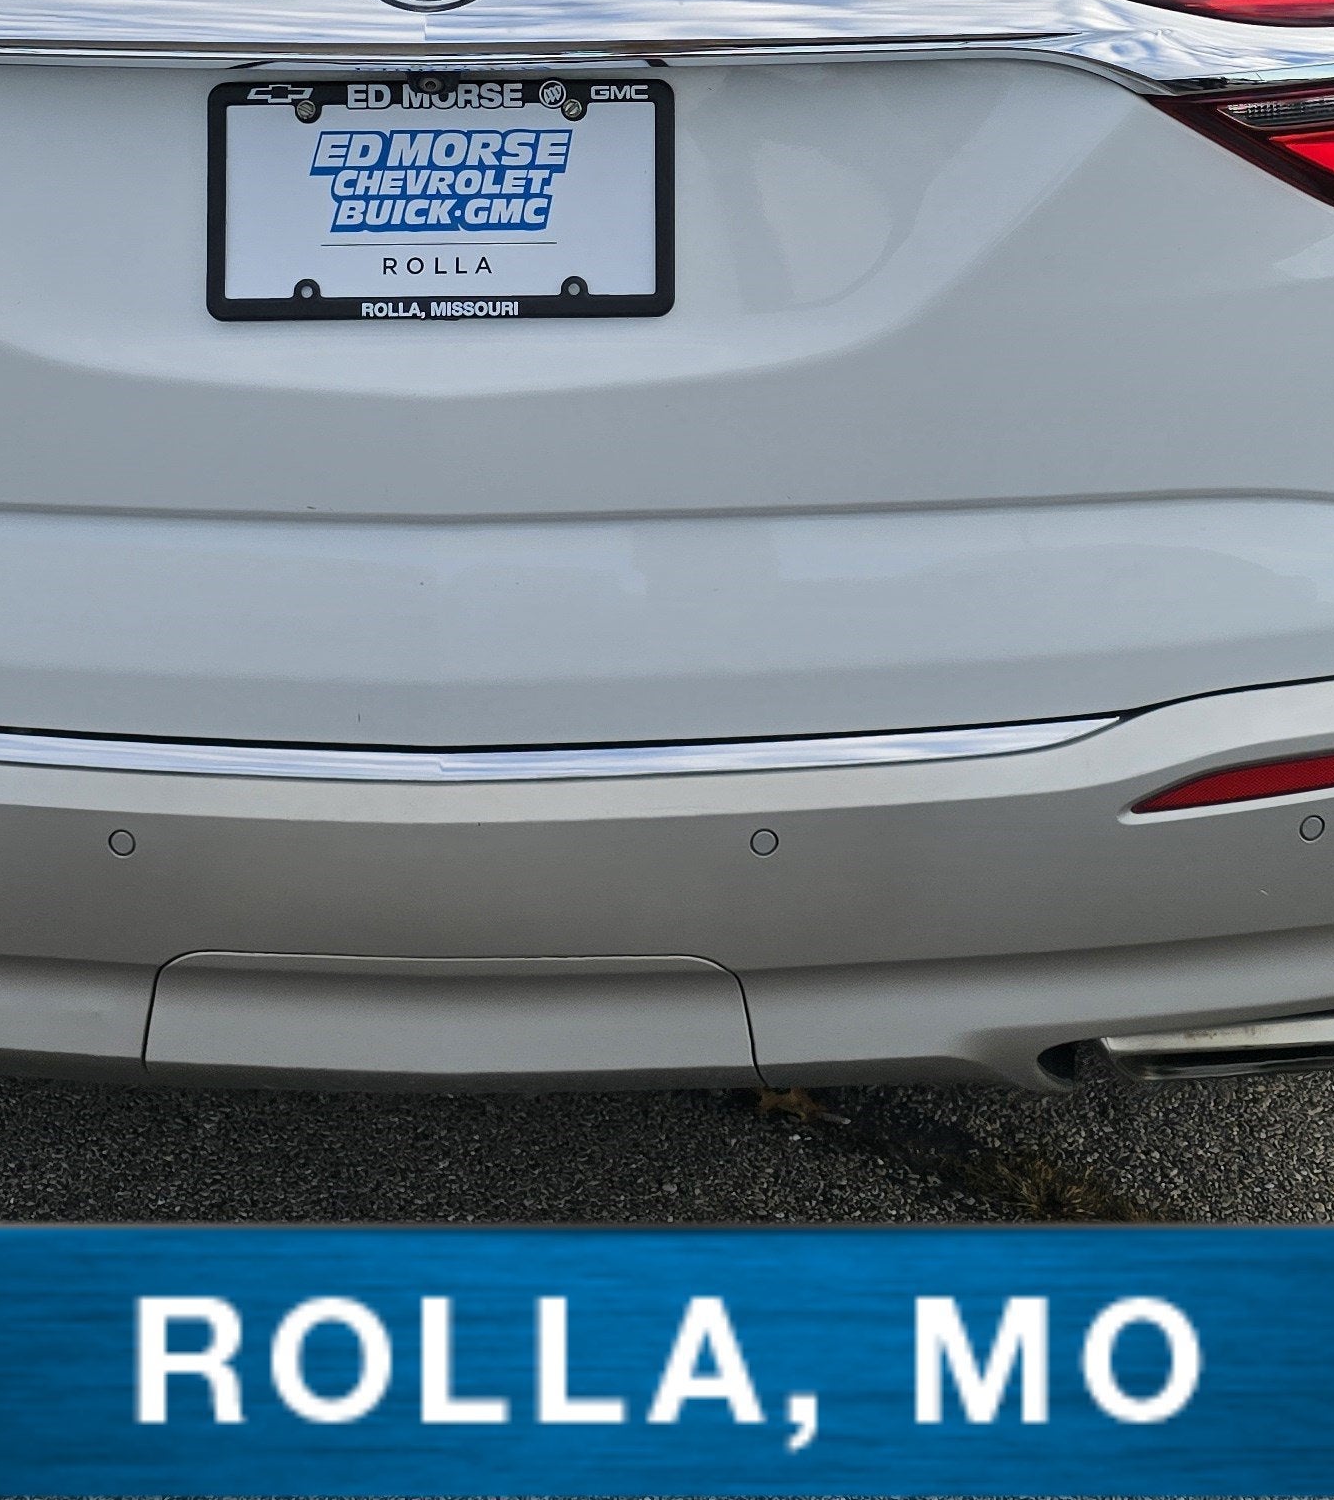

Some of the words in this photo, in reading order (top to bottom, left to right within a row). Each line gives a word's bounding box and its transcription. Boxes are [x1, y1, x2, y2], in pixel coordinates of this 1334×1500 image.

[347, 84, 391, 109] ED
[402, 83, 523, 109] MORSE
[590, 84, 649, 100] GMC
[314, 133, 386, 167] ED
[386, 132, 570, 166] MORSE
[333, 169, 551, 197] CHEVROLET
[382, 257, 493, 275] ROLLA
[361, 303, 426, 320] ROLLA,
[430, 301, 520, 317] MISSOURI
